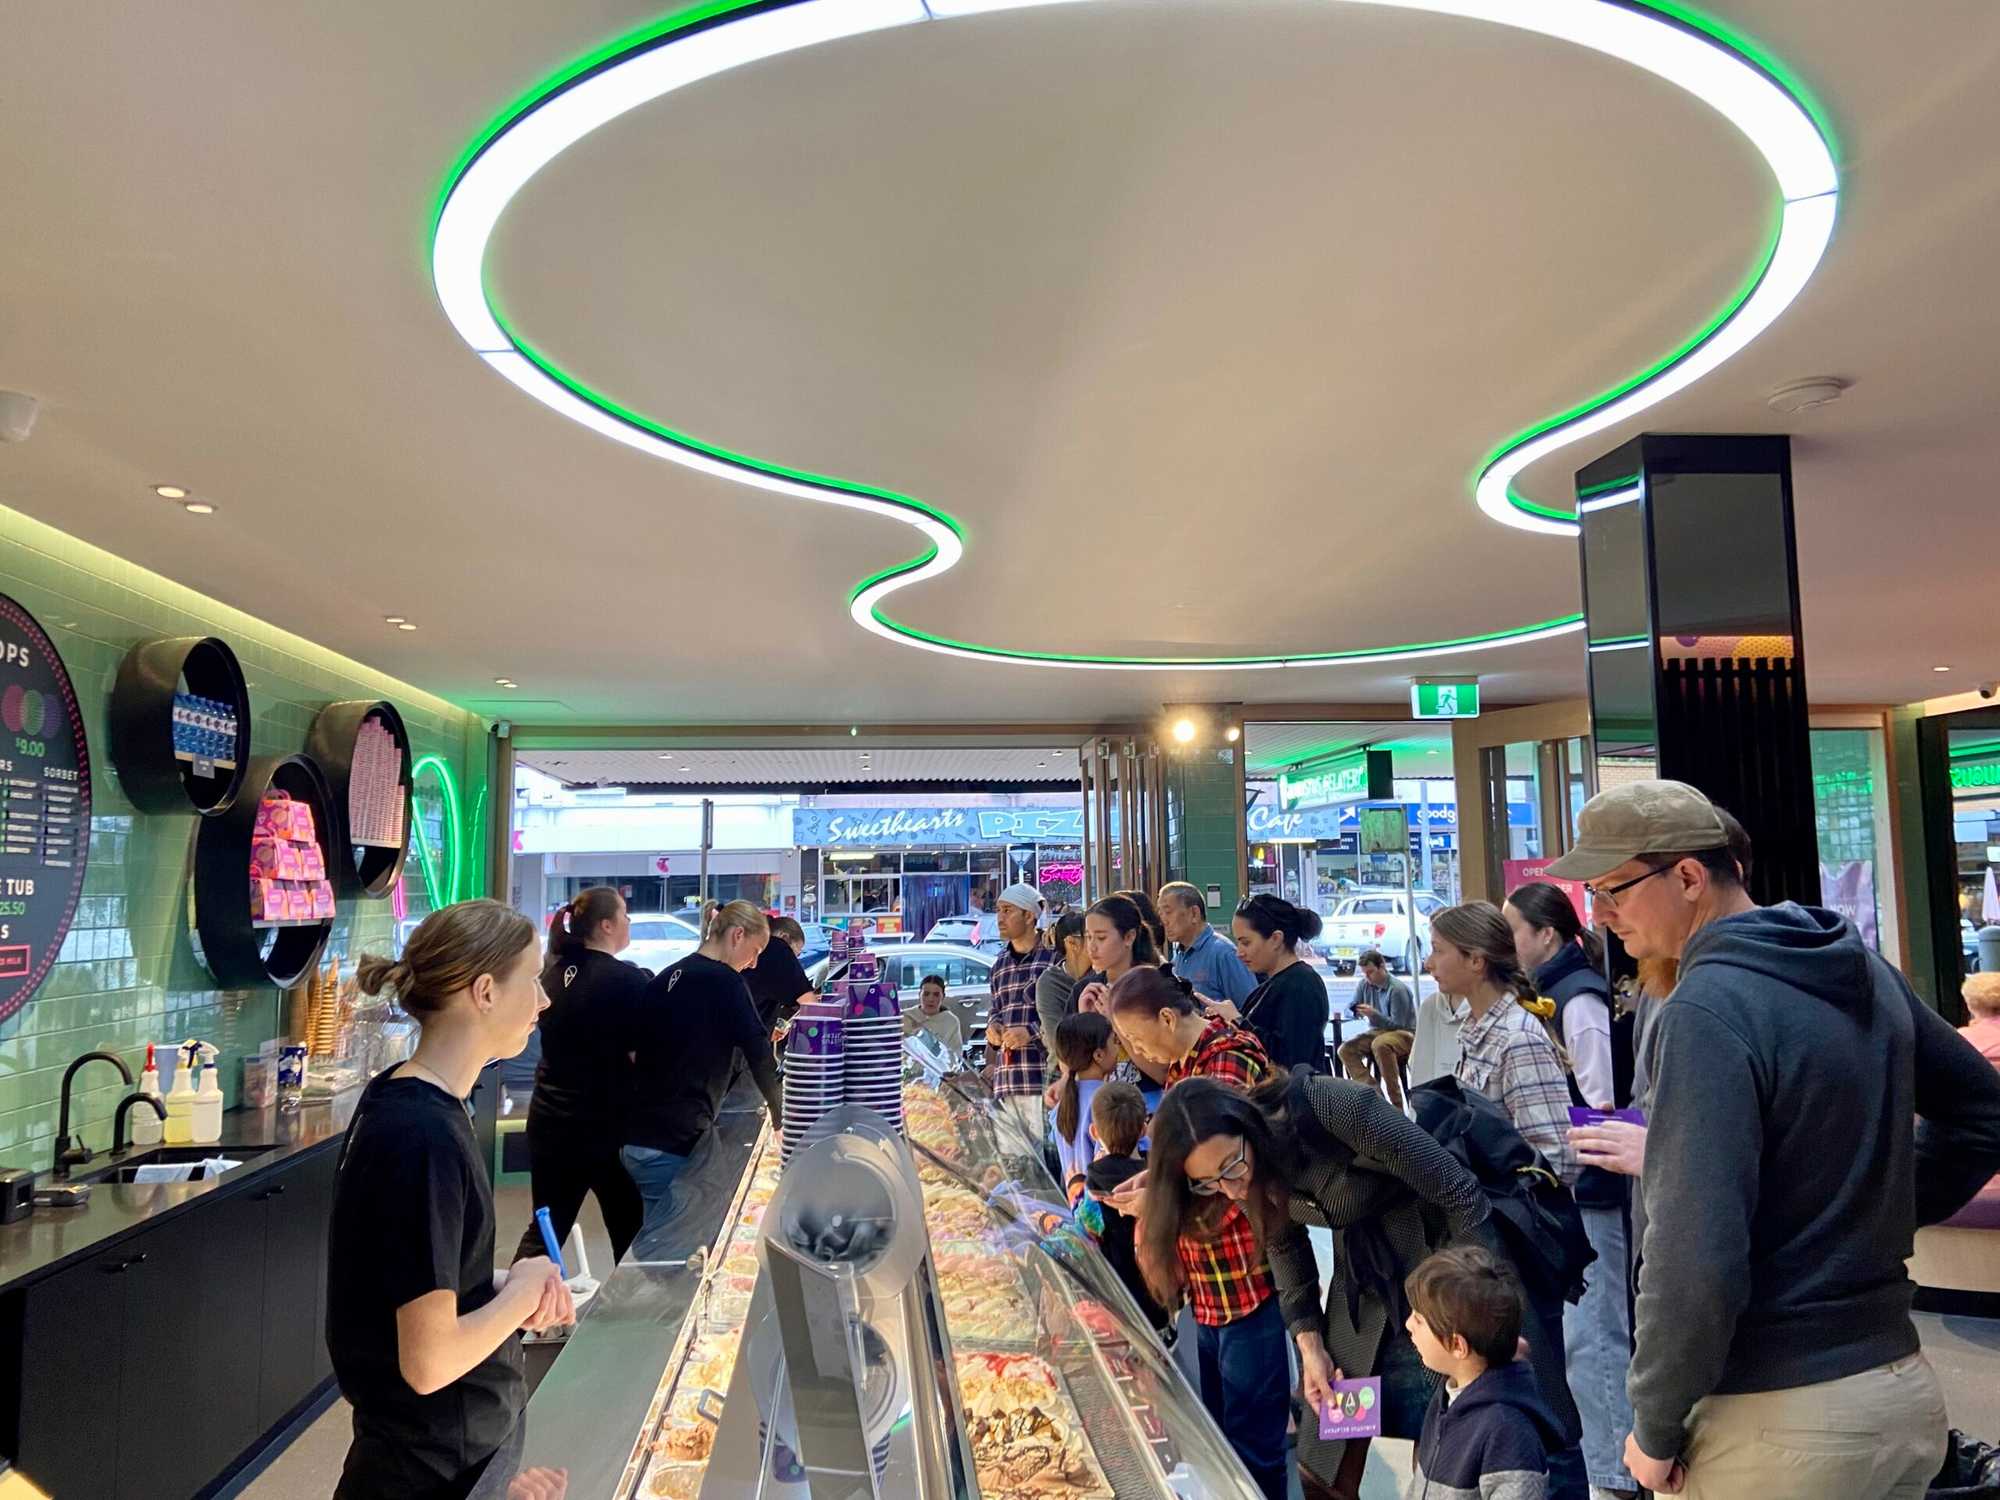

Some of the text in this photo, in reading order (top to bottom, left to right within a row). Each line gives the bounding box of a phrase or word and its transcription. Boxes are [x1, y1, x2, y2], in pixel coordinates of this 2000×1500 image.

[43, 766, 79, 780] SORBET
[828, 808, 965, 842] Sweethearts
[6, 878, 34, 895] TUB
